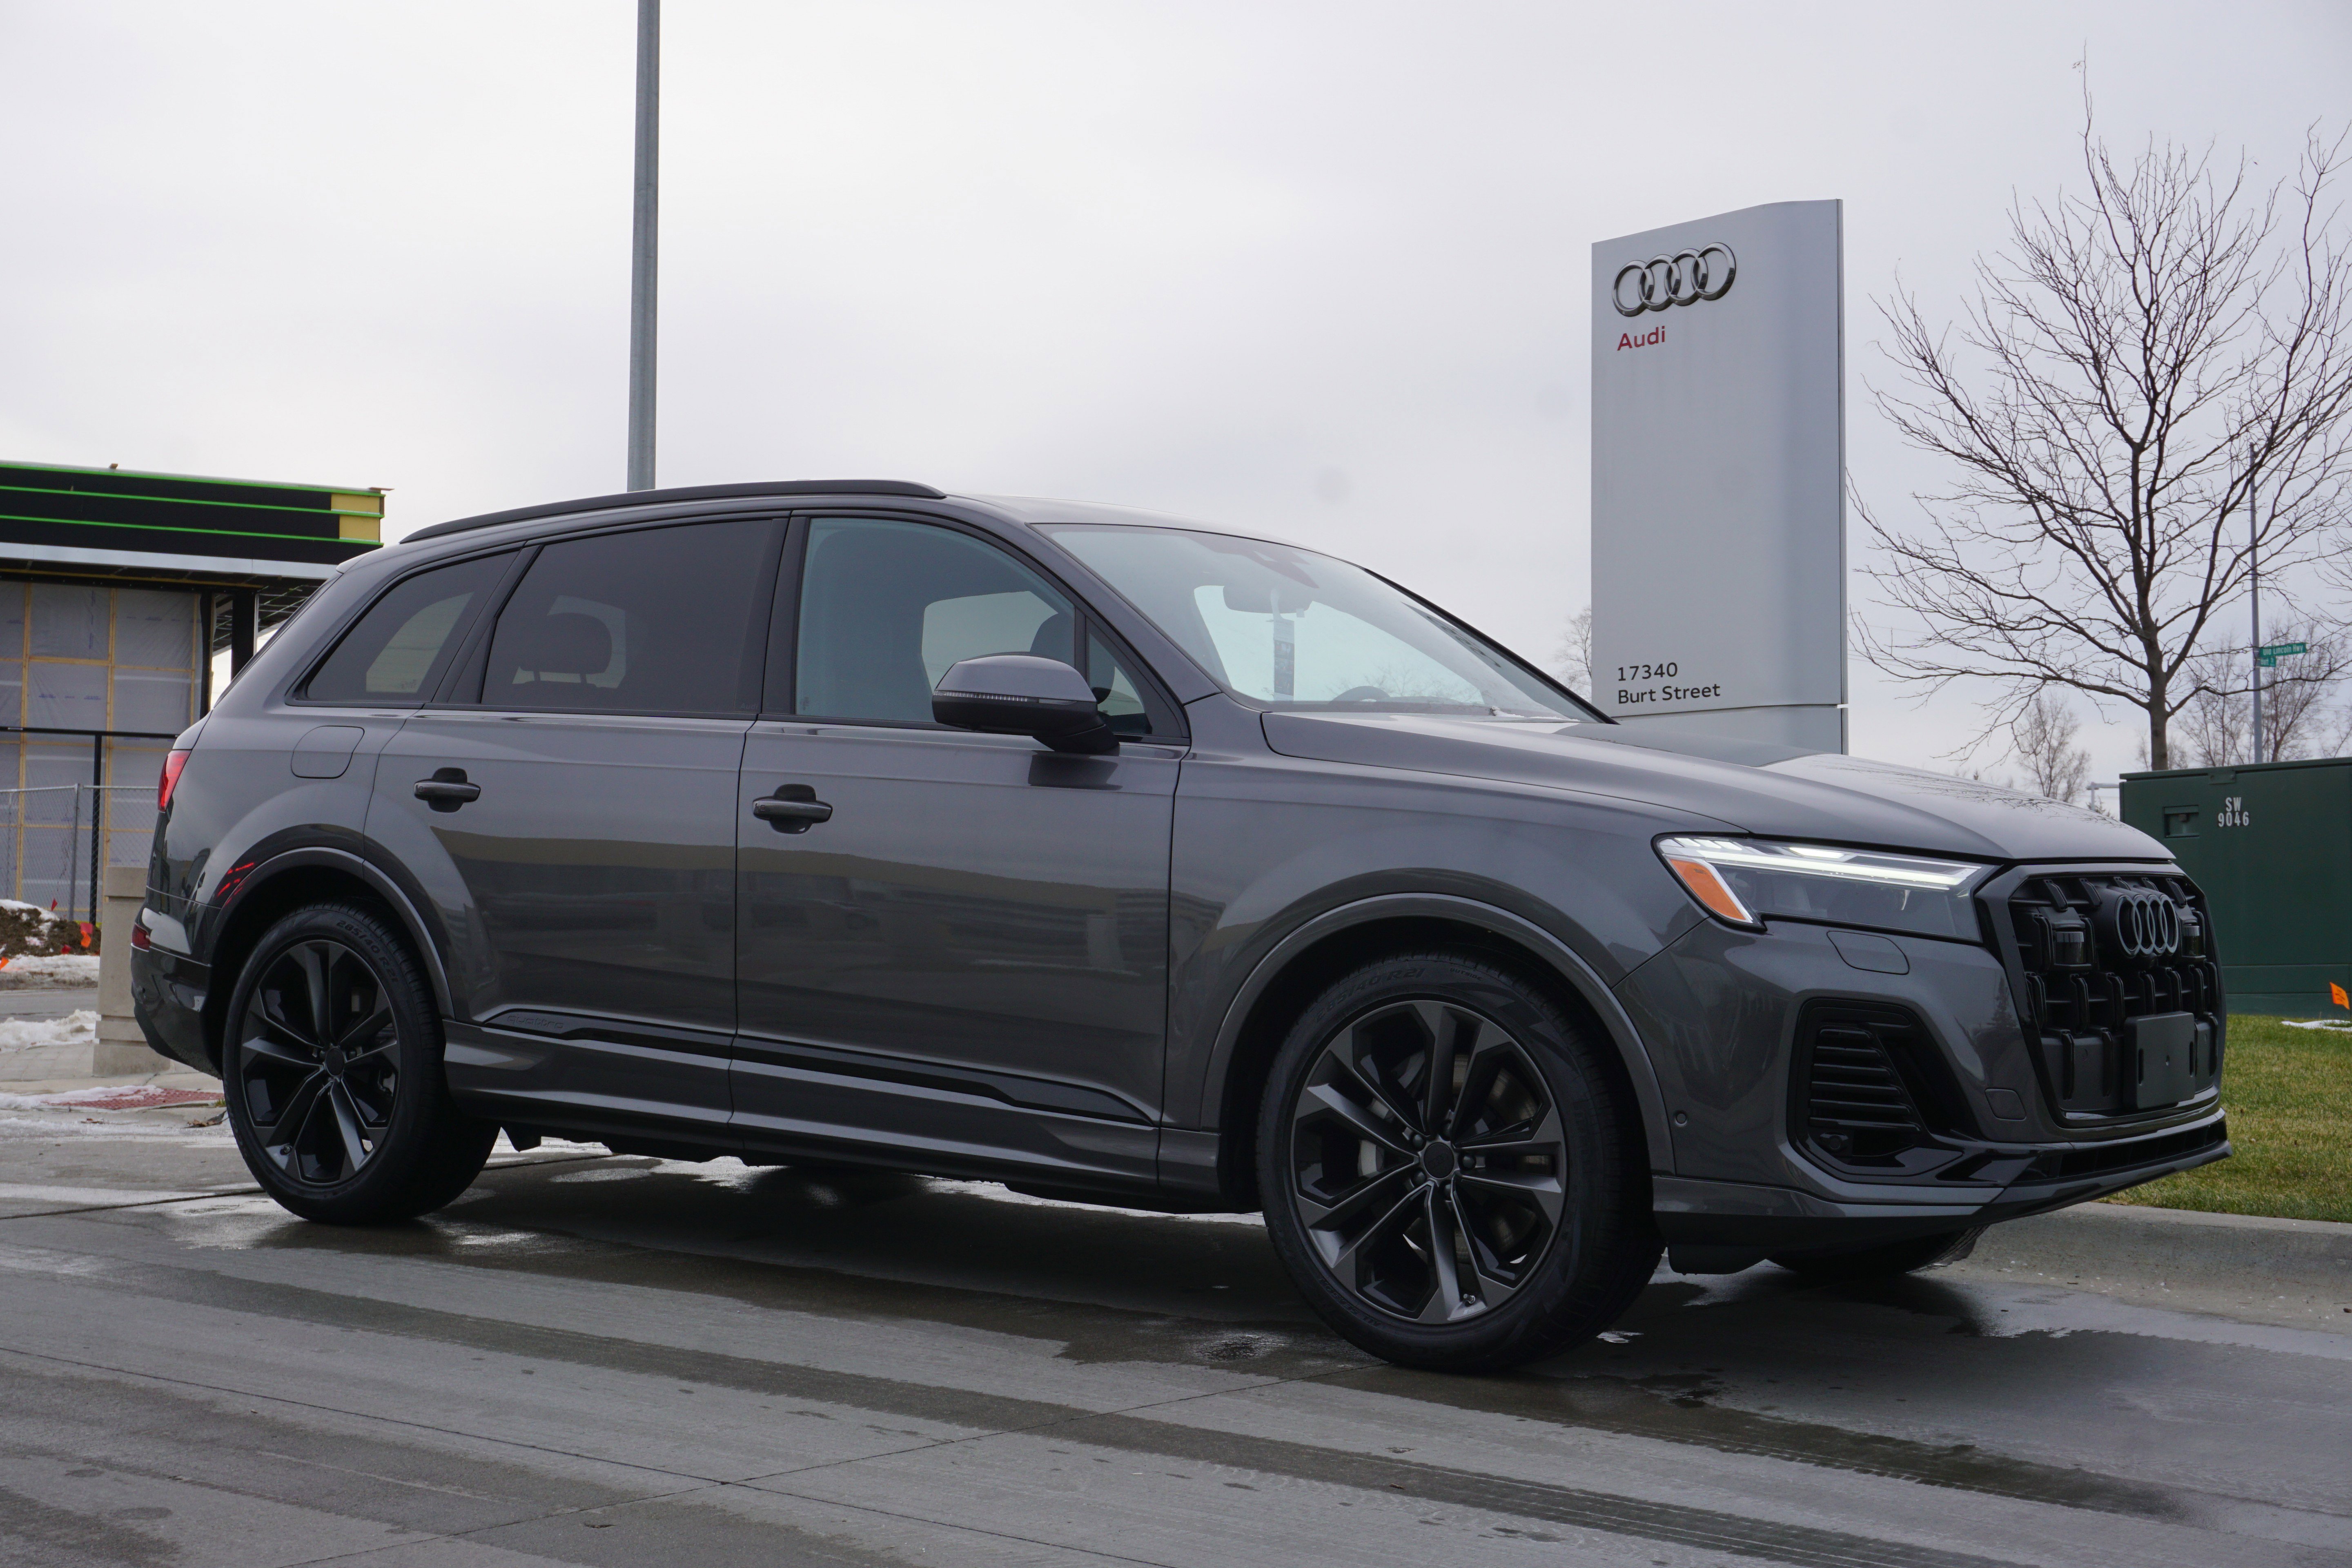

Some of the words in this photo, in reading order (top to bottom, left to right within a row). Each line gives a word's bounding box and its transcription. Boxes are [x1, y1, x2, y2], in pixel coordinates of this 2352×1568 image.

[1617, 325, 1665, 351] Audi
[2273, 645, 2292, 654] Lincoln
[2293, 644, 2303, 653] Hwy
[1618, 662, 1678, 681] 17340
[1618, 689, 1656, 704] Burt
[1662, 684, 1721, 700] Street
[2225, 797, 2241, 812] SW
[2218, 812, 2250, 828] 9046
[336, 920, 381, 954] 285/40
[379, 957, 399, 982] R21
[1450, 967, 1483, 981] OUTSIDE
[1316, 975, 1382, 1022] 285/40
[1387, 968, 1426, 981] R21
[507, 1015, 564, 1029] quattro
